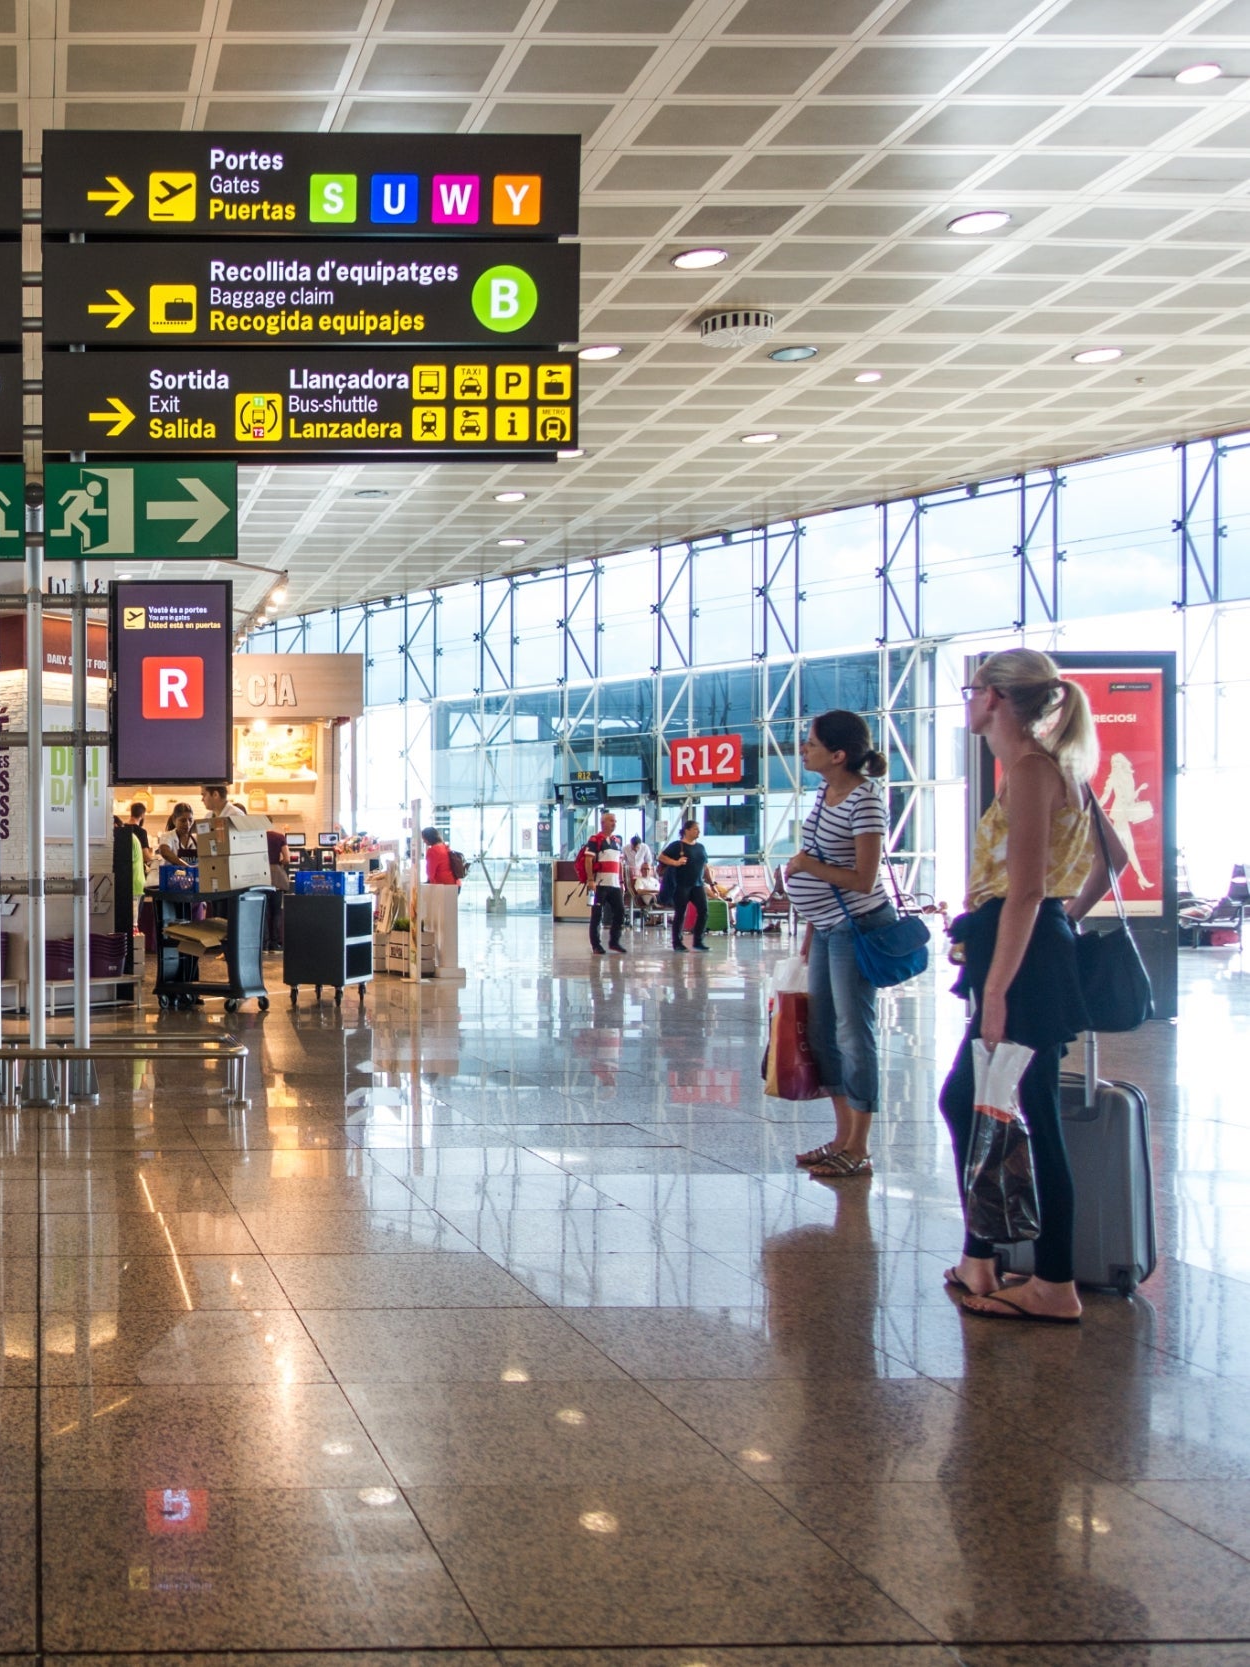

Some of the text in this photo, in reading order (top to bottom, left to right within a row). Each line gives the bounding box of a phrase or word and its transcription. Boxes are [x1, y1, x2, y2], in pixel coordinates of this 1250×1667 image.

[211, 149, 283, 170] Portes
[211, 175, 259, 193] Gates
[323, 184, 529, 214] S U W Y
[210, 199, 295, 220] Puertas
[211, 261, 458, 285] Recollida d'equipatges
[211, 287, 333, 308] Baggage claim
[490, 279, 518, 319] B
[211, 310, 424, 335] Recogida equipajes
[150, 370, 229, 389] Sortida
[290, 369, 408, 394] Llançadora
[505, 373, 521, 394] P
[150, 396, 180, 412] Exit
[254, 398, 263, 406] T1
[289, 395, 377, 412] Bus-shuttle
[150, 418, 215, 438] Salida
[290, 418, 402, 438] Lanzadera
[148, 606, 168, 614] Vostè
[169, 606, 177, 614] és
[185, 607, 207, 616] portes
[195, 622, 221, 630] puertas
[47, 653, 66, 665] DAILY
[159, 669, 188, 708] R
[676, 743, 735, 777] R12
[578, 771, 591, 780] R12
